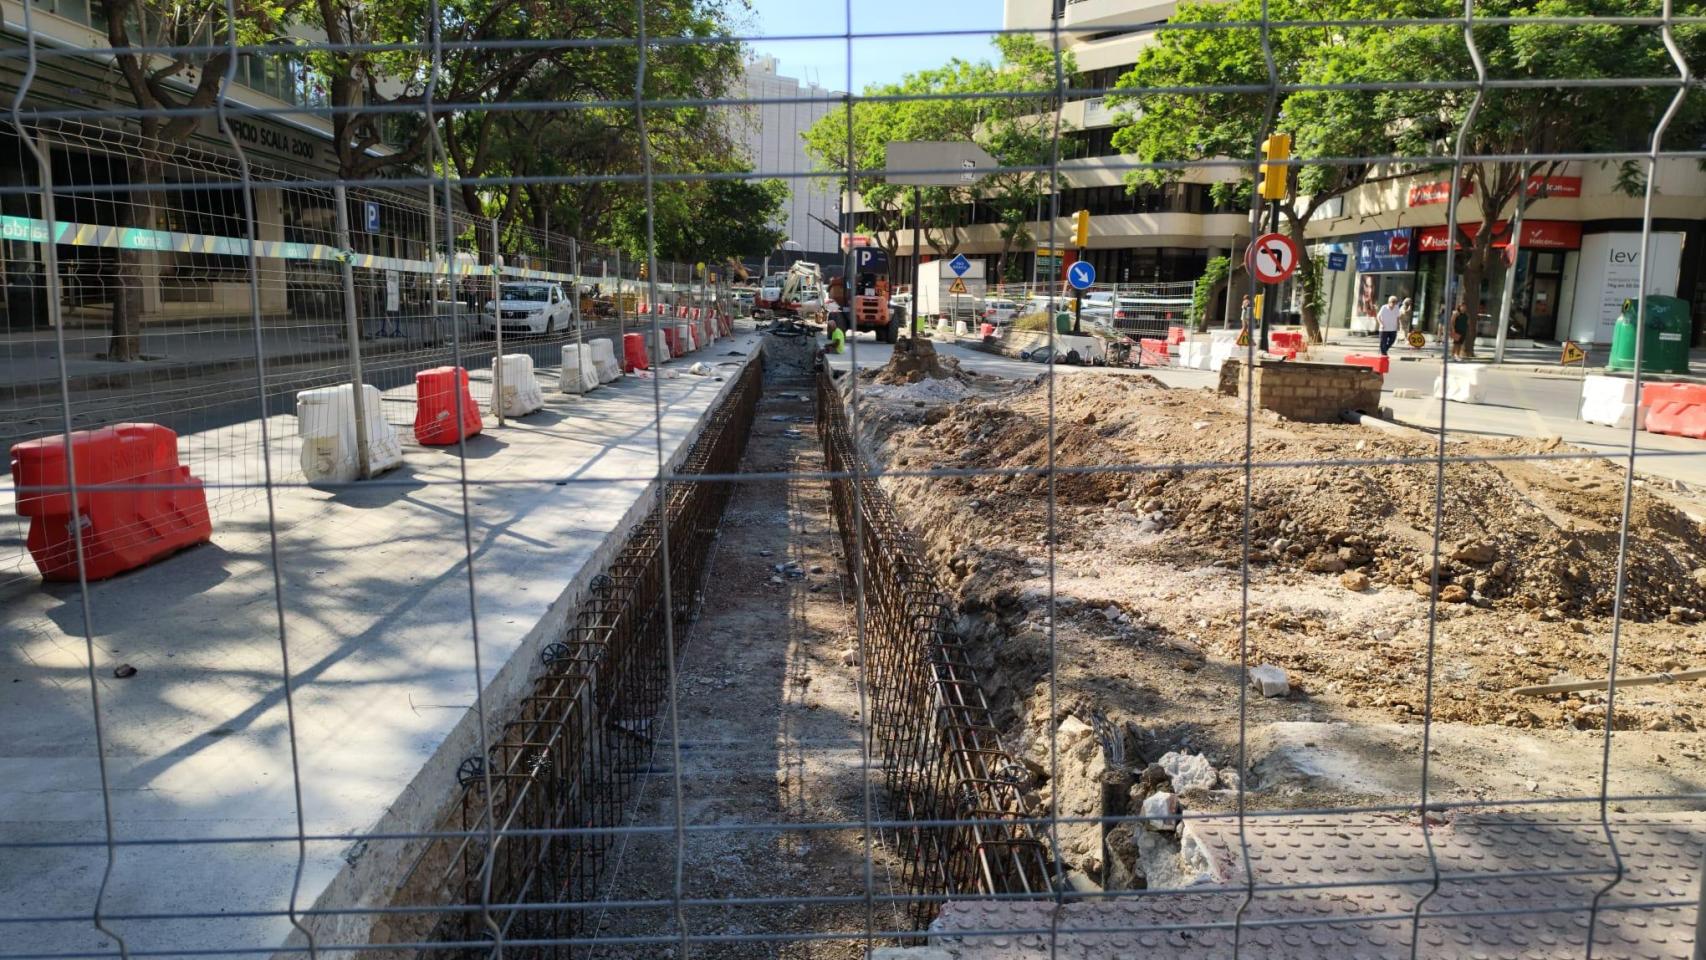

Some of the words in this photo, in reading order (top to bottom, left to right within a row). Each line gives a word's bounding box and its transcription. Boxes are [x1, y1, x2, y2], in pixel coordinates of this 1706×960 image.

[261, 127, 289, 152] SCALA
[292, 138, 313, 159] 2000
[368, 206, 376, 229] P
[861, 251, 871, 266] P
[1411, 336, 1422, 344] 20
